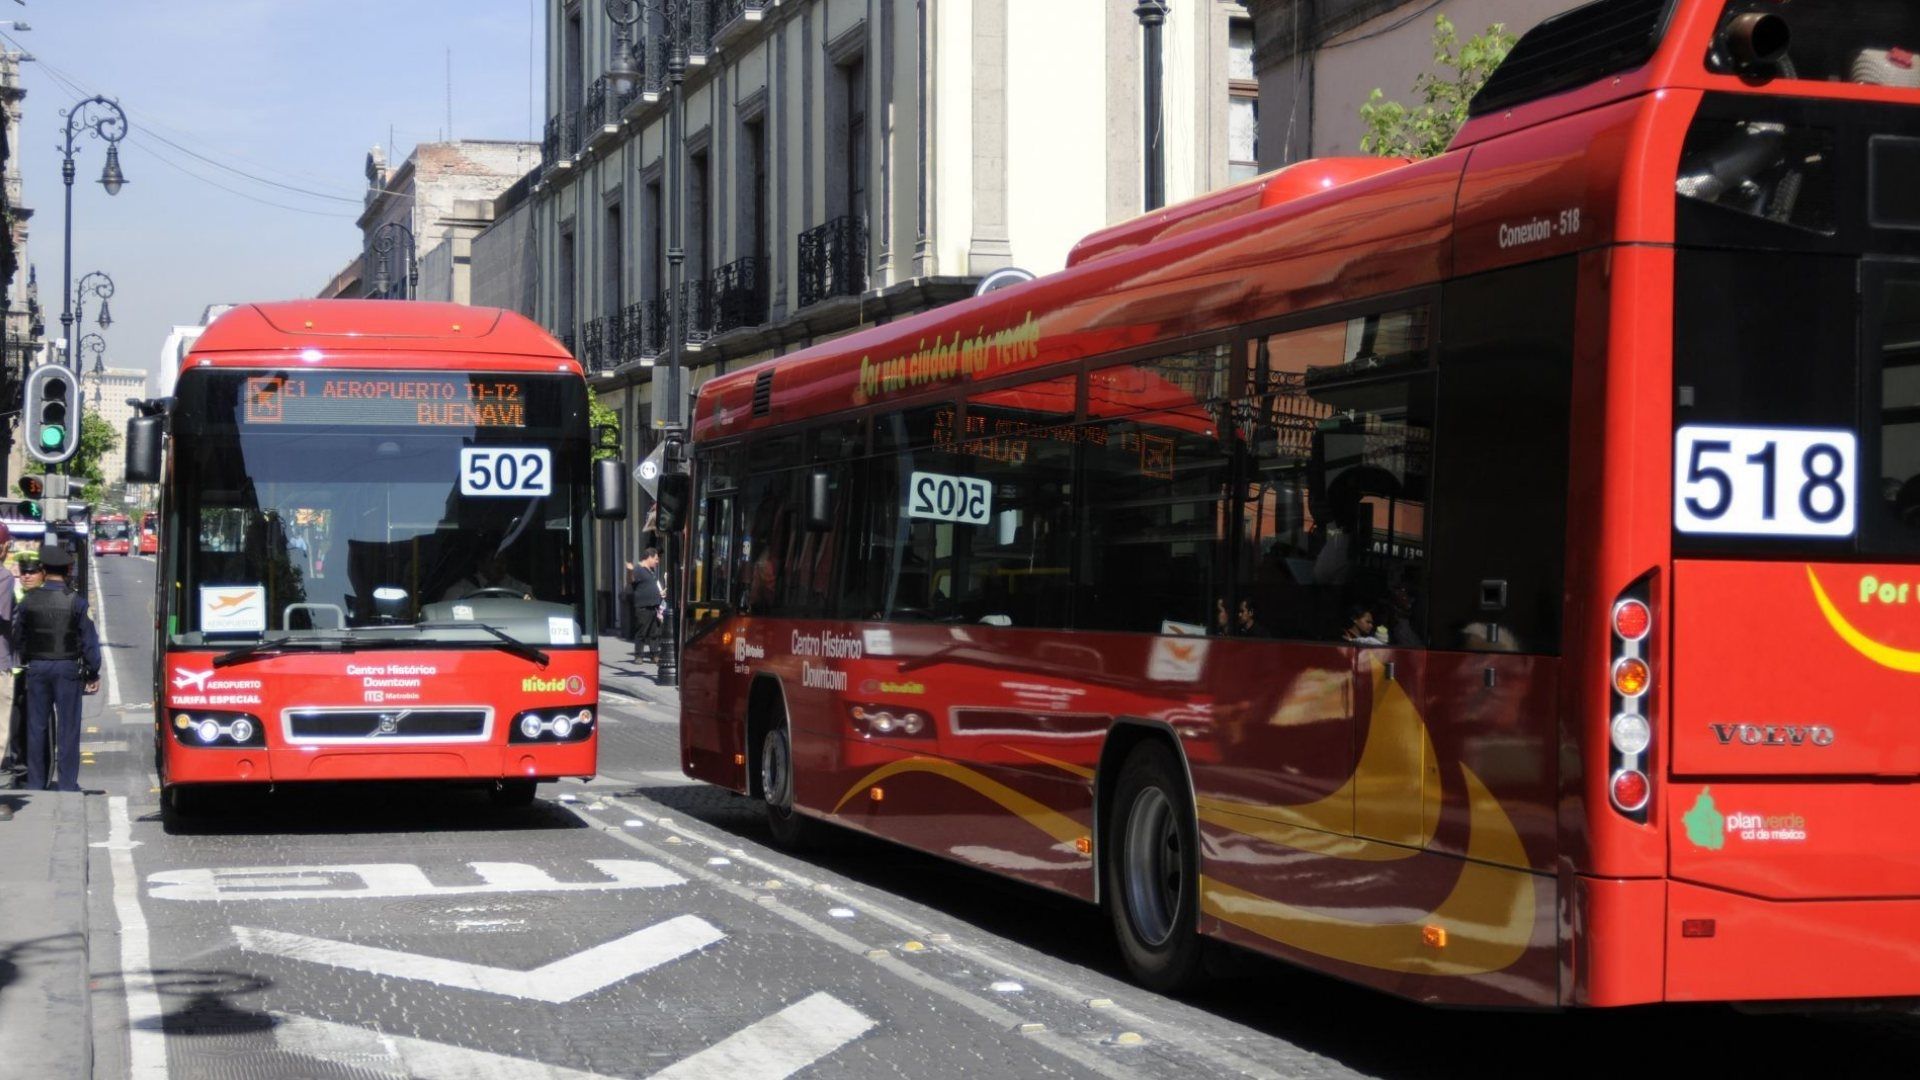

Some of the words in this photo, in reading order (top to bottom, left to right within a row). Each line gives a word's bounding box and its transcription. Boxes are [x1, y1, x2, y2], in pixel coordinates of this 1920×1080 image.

[1499, 216, 1551, 249] Conexion
[1559, 207, 1580, 236] 518
[909, 331, 960, 387] ciudad
[323, 381, 456, 400] AEROPUERTO
[464, 383, 519, 401] T1-T2
[468, 453, 544, 490] 502
[1683, 439, 1847, 524] 518
[1859, 575, 1909, 604] Por
[791, 628, 820, 658] Centro
[821, 630, 863, 661] Histórico
[346, 664, 385, 675] Centro
[386, 664, 437, 675] Histórico
[363, 676, 421, 688] Downtown
[802, 661, 847, 692] Downtown
[207, 680, 262, 690] AEROPUERTO
[171, 695, 207, 705] TARIFA
[209, 695, 262, 705] ESPECIAL
[1708, 723, 1835, 747] VOLVO
[1756, 829, 1770, 840] de
